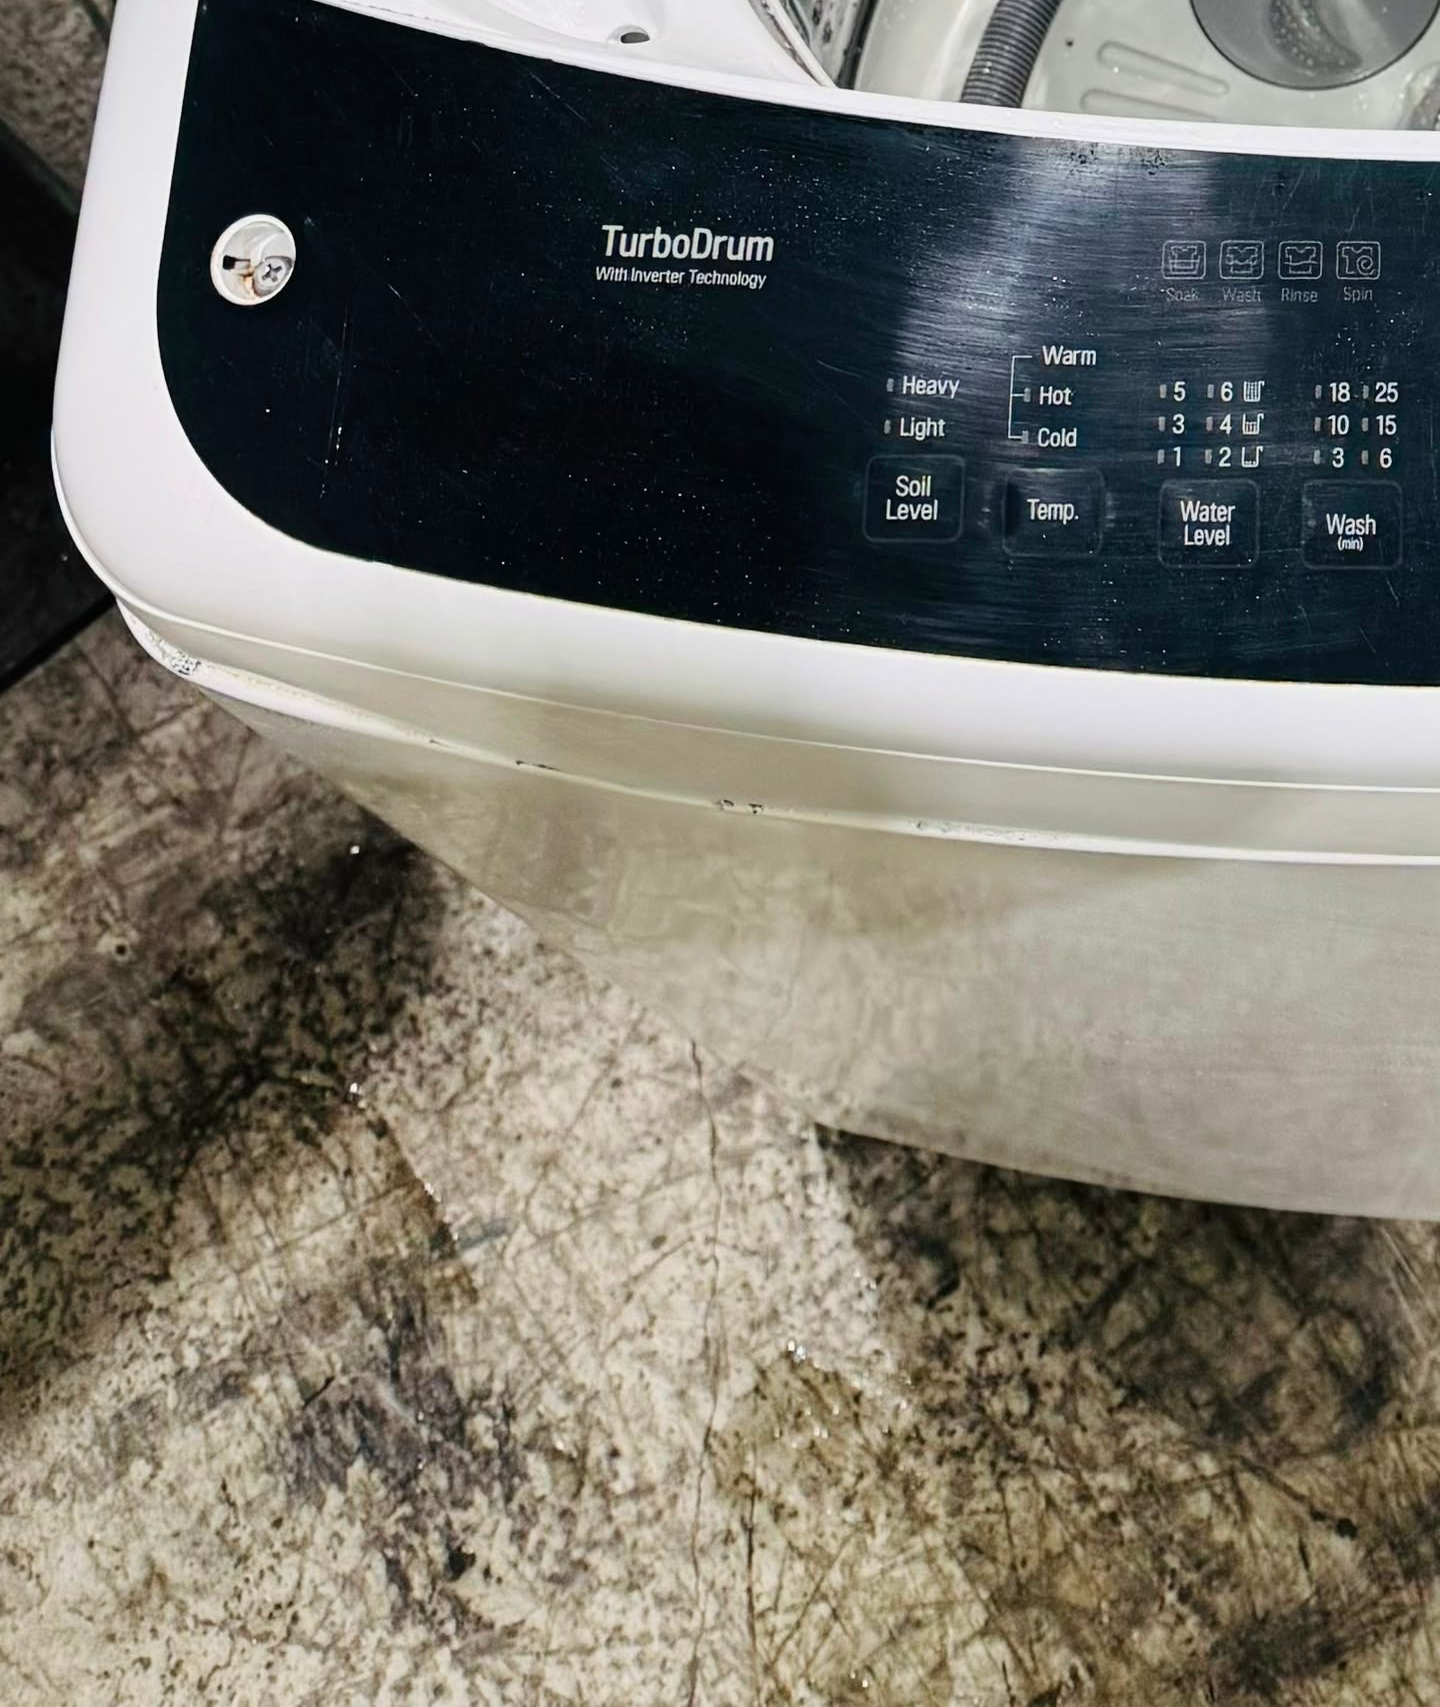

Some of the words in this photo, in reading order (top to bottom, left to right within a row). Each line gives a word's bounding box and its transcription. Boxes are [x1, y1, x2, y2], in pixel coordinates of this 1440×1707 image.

[601, 224, 774, 263] TurboDrum
[595, 265, 628, 283] With
[631, 268, 685, 285] Inverter
[689, 268, 767, 290] Technology
[1165, 287, 1200, 302] Soak
[1221, 287, 1261, 302] Wash
[1281, 287, 1318, 303] Rinse
[1343, 287, 1373, 304] Spin
[1041, 346, 1097, 367] Warm
[902, 375, 960, 400] Heavy
[1039, 386, 1074, 406] Hot
[1173, 382, 1186, 402] 5
[1220, 382, 1233, 403] 6
[1329, 382, 1351, 403] 18
[1375, 382, 1399, 403] 25
[899, 417, 946, 440] Light
[1172, 415, 1186, 435] 3
[1219, 415, 1233, 435] 4
[1328, 415, 1350, 436] 10
[1376, 415, 1398, 436] 15
[1038, 428, 1078, 449] Cold
[1173, 448, 1182, 467] 1
[1218, 448, 1231, 468] 2
[1332, 449, 1345, 469] 3
[1380, 449, 1392, 469] 6
[895, 475, 932, 498] Soil
[885, 500, 938, 522] Level
[1027, 498, 1080, 524] Temp.
[1180, 500, 1236, 523] Water
[1326, 513, 1377, 536] Wash
[1183, 524, 1231, 547] Level
[1337, 536, 1364, 552] (min)
